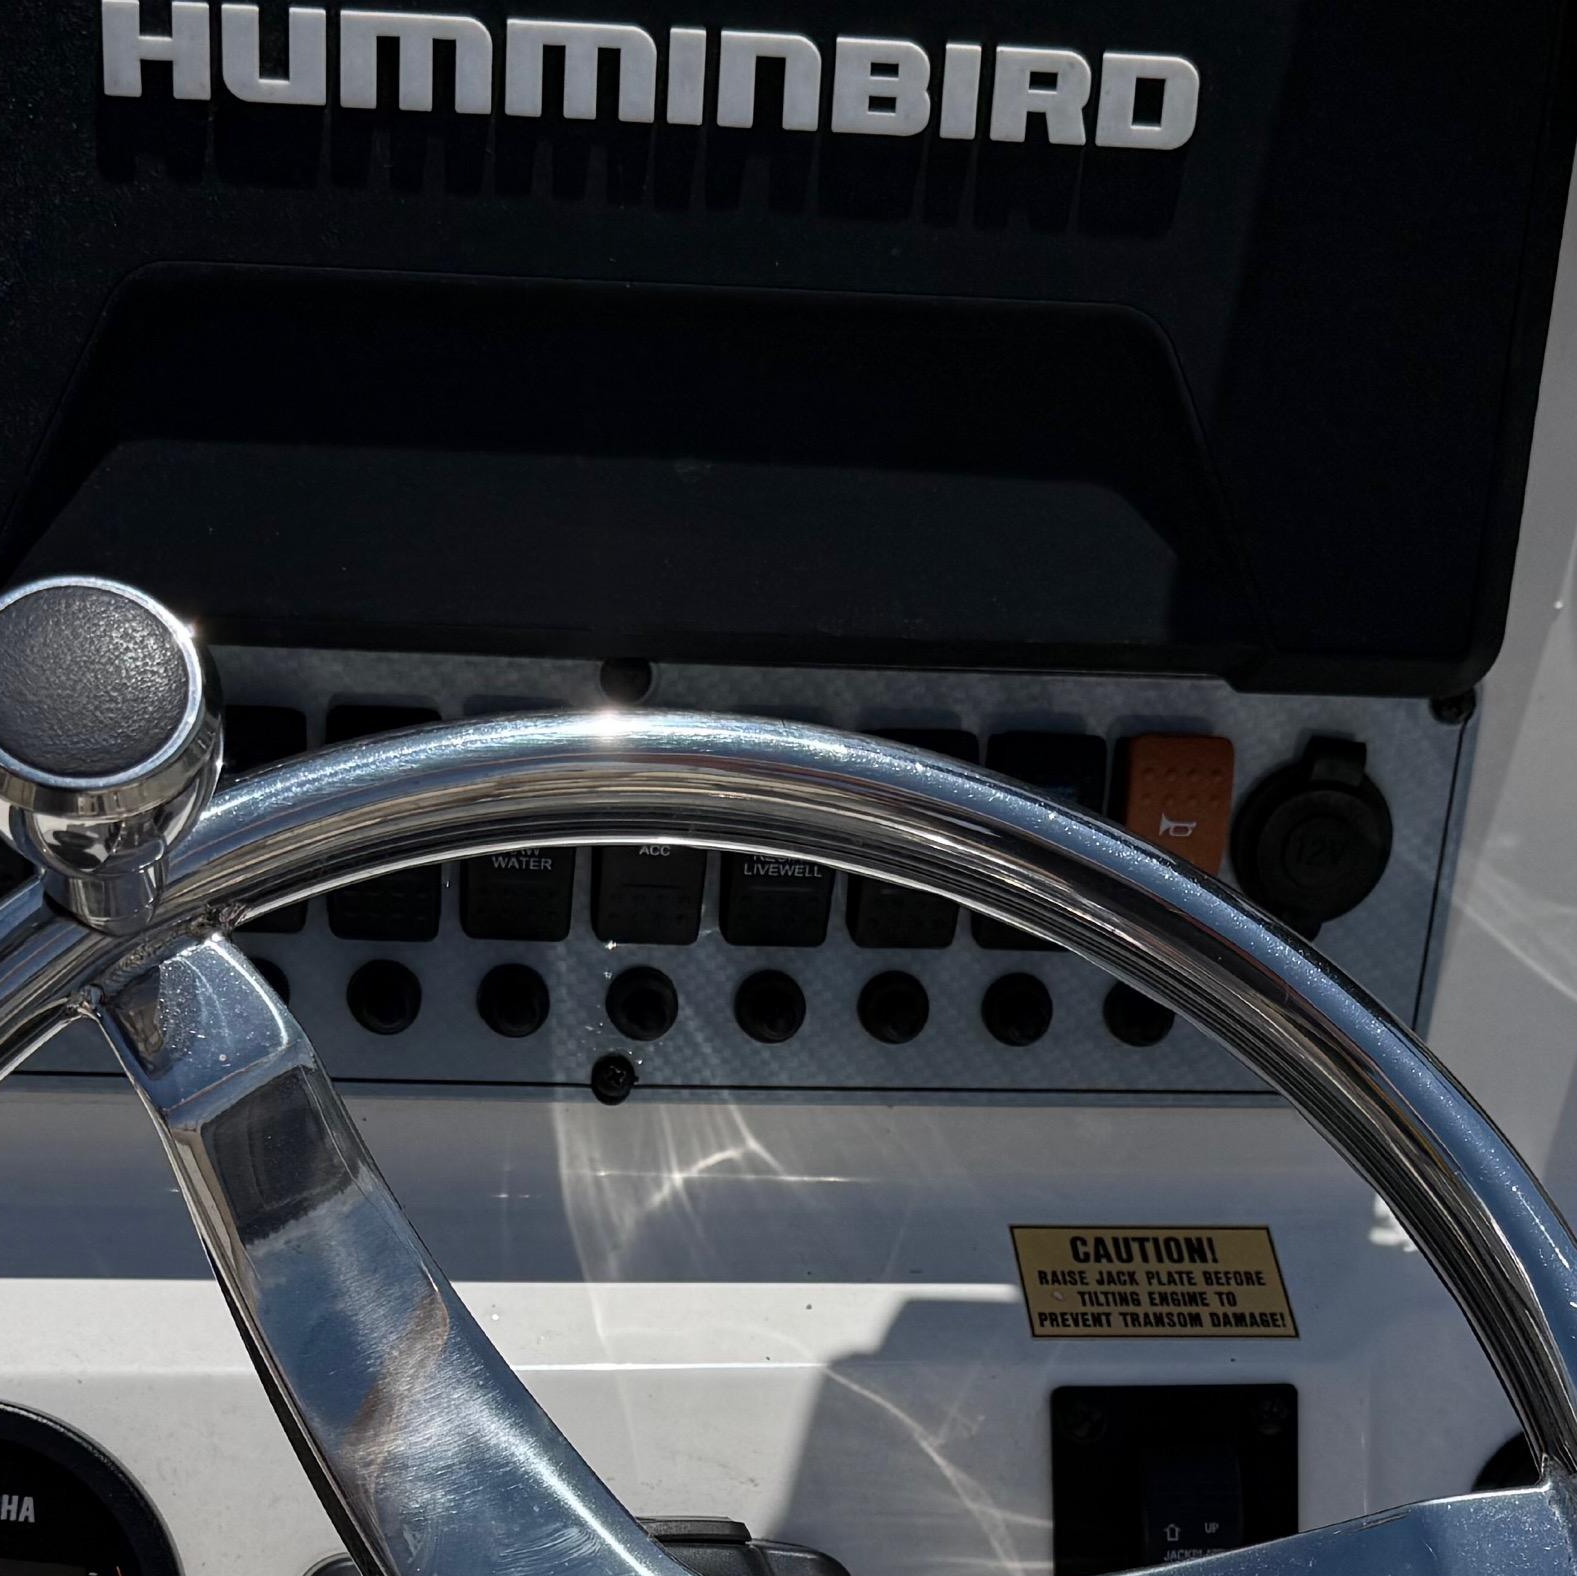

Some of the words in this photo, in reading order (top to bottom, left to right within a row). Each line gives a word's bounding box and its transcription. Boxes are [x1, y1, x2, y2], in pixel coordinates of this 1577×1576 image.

[102, 0, 1198, 154] HUMMINBIRD
[639, 845, 671, 857] ACC
[492, 855, 553, 871] WATER
[744, 863, 823, 878] LIVEWELL
[1070, 1235, 1219, 1265] CAUTION!
[1037, 1270, 1090, 1287] RAISE
[1095, 1270, 1140, 1287] JACK
[1146, 1270, 1195, 1287] PLATE
[1203, 1270, 1267, 1287] BEFORE
[1077, 1291, 1141, 1308] TILTING
[1149, 1291, 1210, 1308] ENGINE
[1214, 1291, 1238, 1308] TO
[1038, 1312, 1113, 1329] PREVENT
[1119, 1312, 1204, 1329] TRANSOM
[1210, 1312, 1287, 1329] DAMAGE!
[1204, 1522, 1220, 1535] UP
